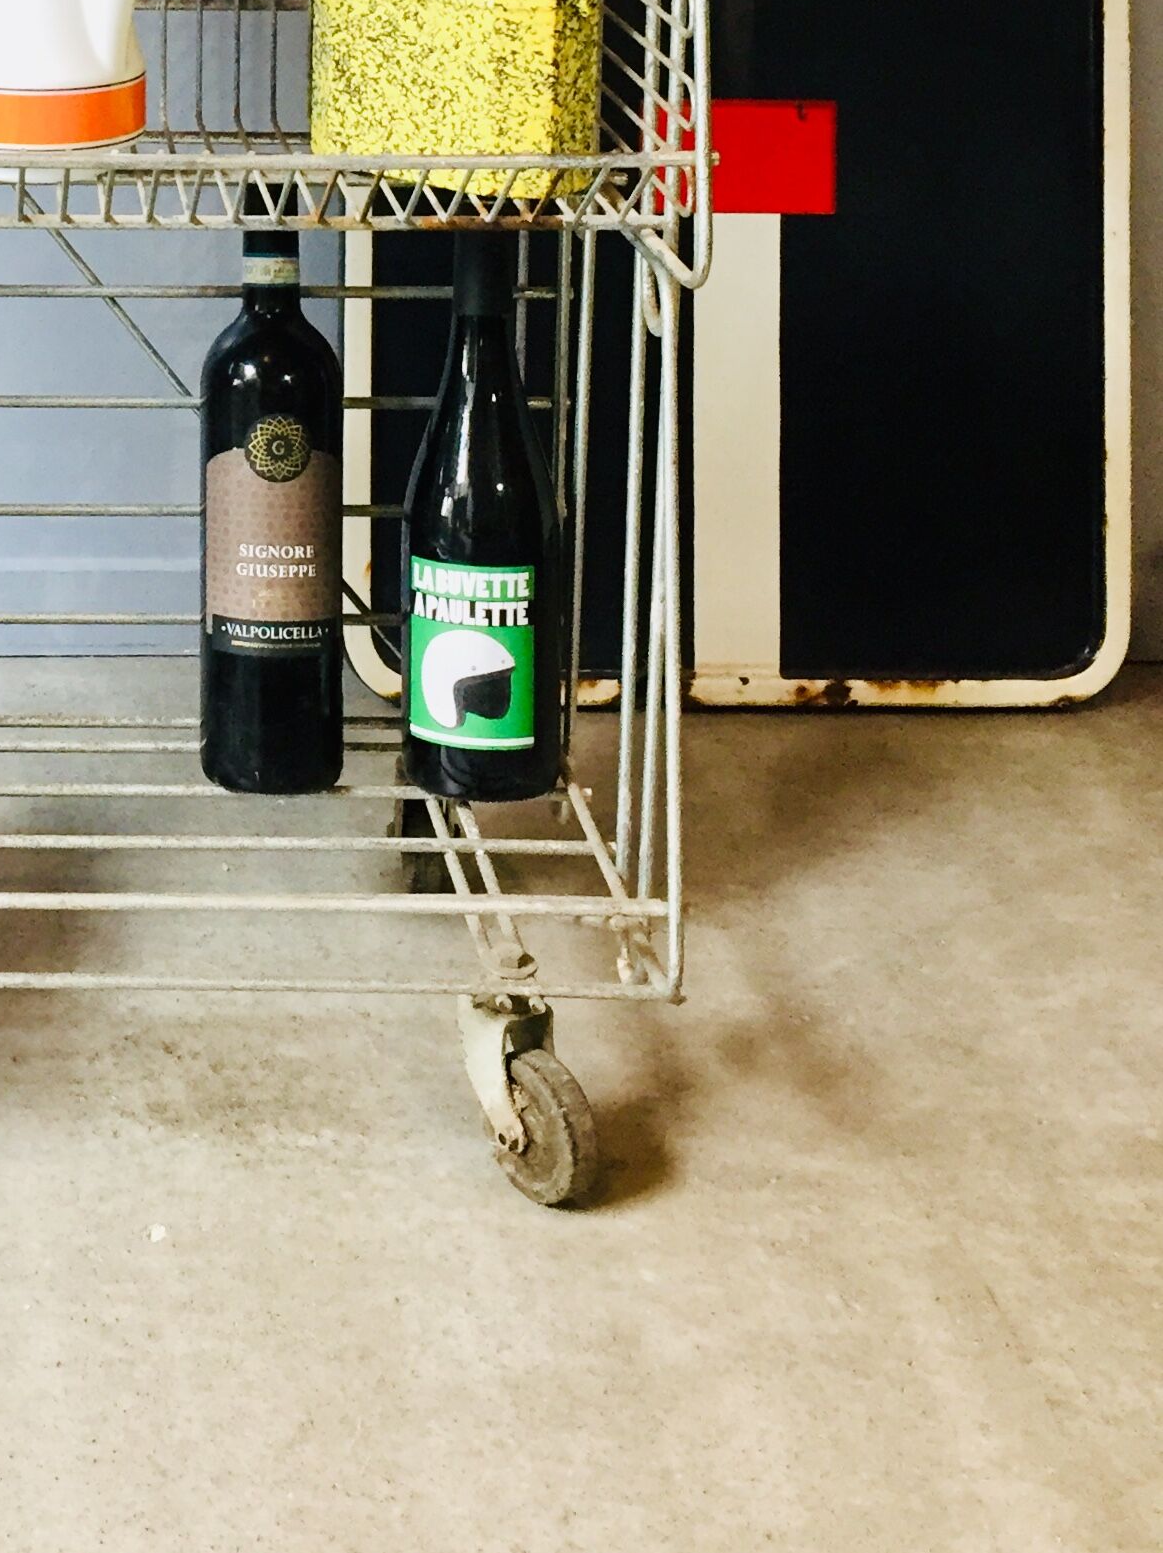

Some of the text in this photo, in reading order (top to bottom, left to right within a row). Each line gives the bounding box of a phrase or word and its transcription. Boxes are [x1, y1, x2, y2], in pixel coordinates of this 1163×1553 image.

[239, 543, 315, 559] SIGNORE
[236, 562, 316, 578] GIUSEPPE
[225, 622, 323, 640] VALPOLICELLA
